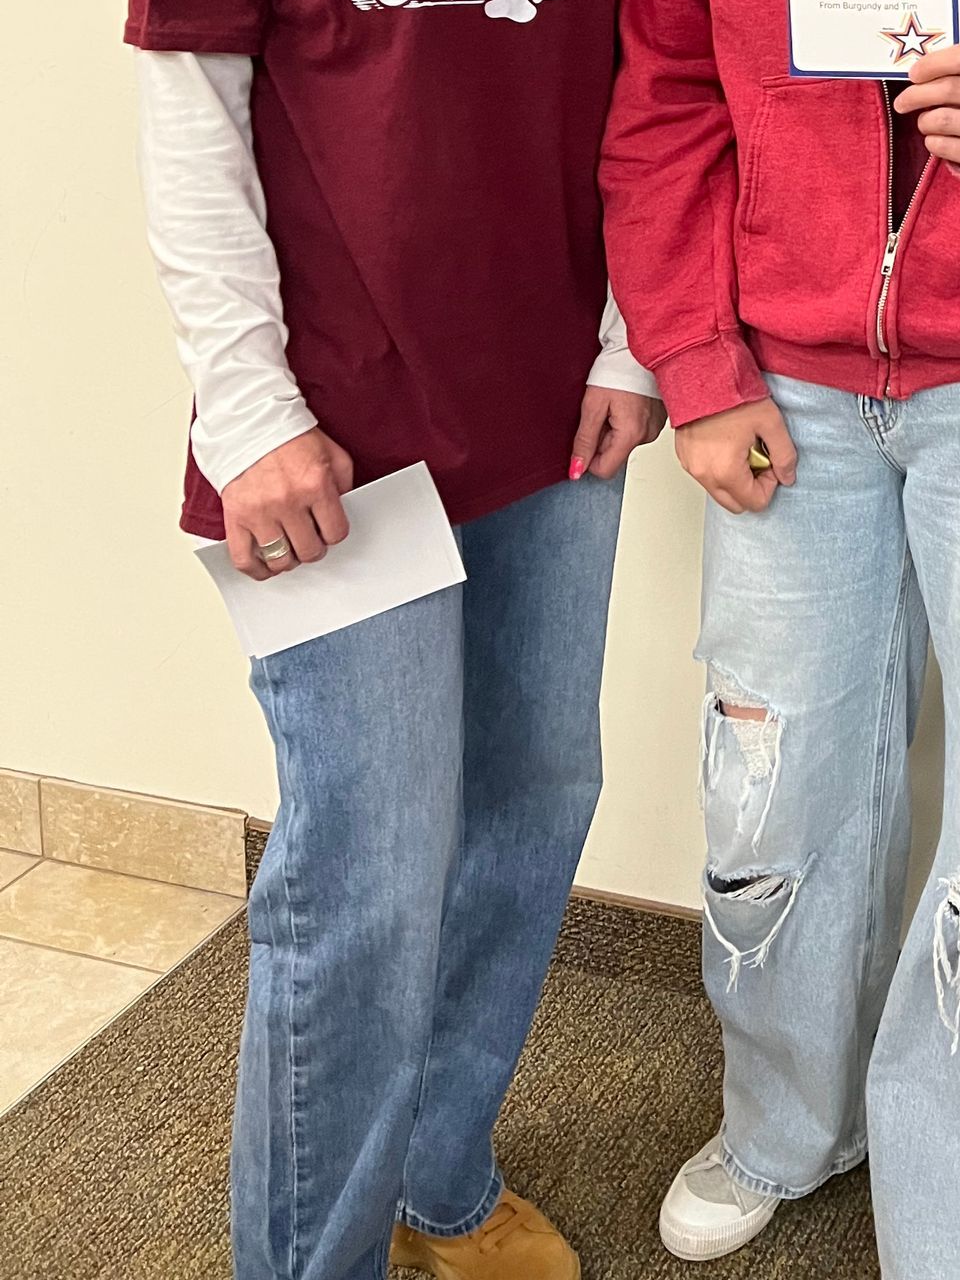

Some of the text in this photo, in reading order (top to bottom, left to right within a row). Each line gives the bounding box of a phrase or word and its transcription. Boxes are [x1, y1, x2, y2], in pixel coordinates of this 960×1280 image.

[819, 1, 918, 12] From Burgundy and Tim
